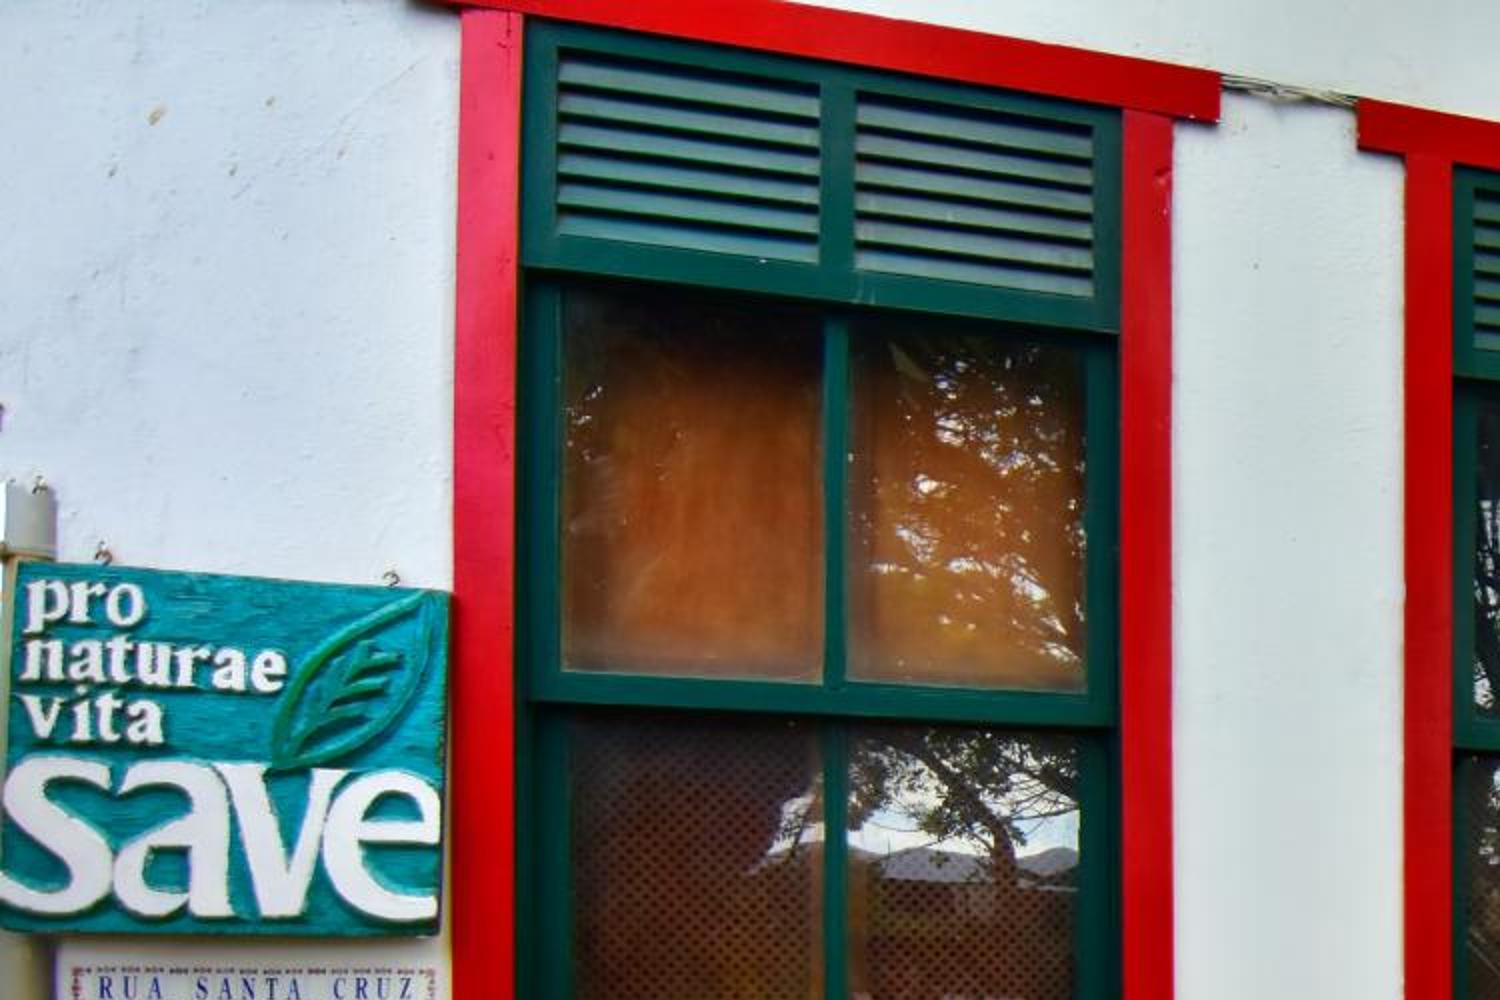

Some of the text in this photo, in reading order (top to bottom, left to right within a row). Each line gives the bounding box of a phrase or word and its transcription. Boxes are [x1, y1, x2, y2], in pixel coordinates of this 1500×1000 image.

[23, 578, 145, 634] pro
[19, 633, 289, 693] naturae
[19, 686, 165, 744] vita
[0, 754, 441, 921] save
[99, 976, 413, 1000] RUA SANTA CRUZ
